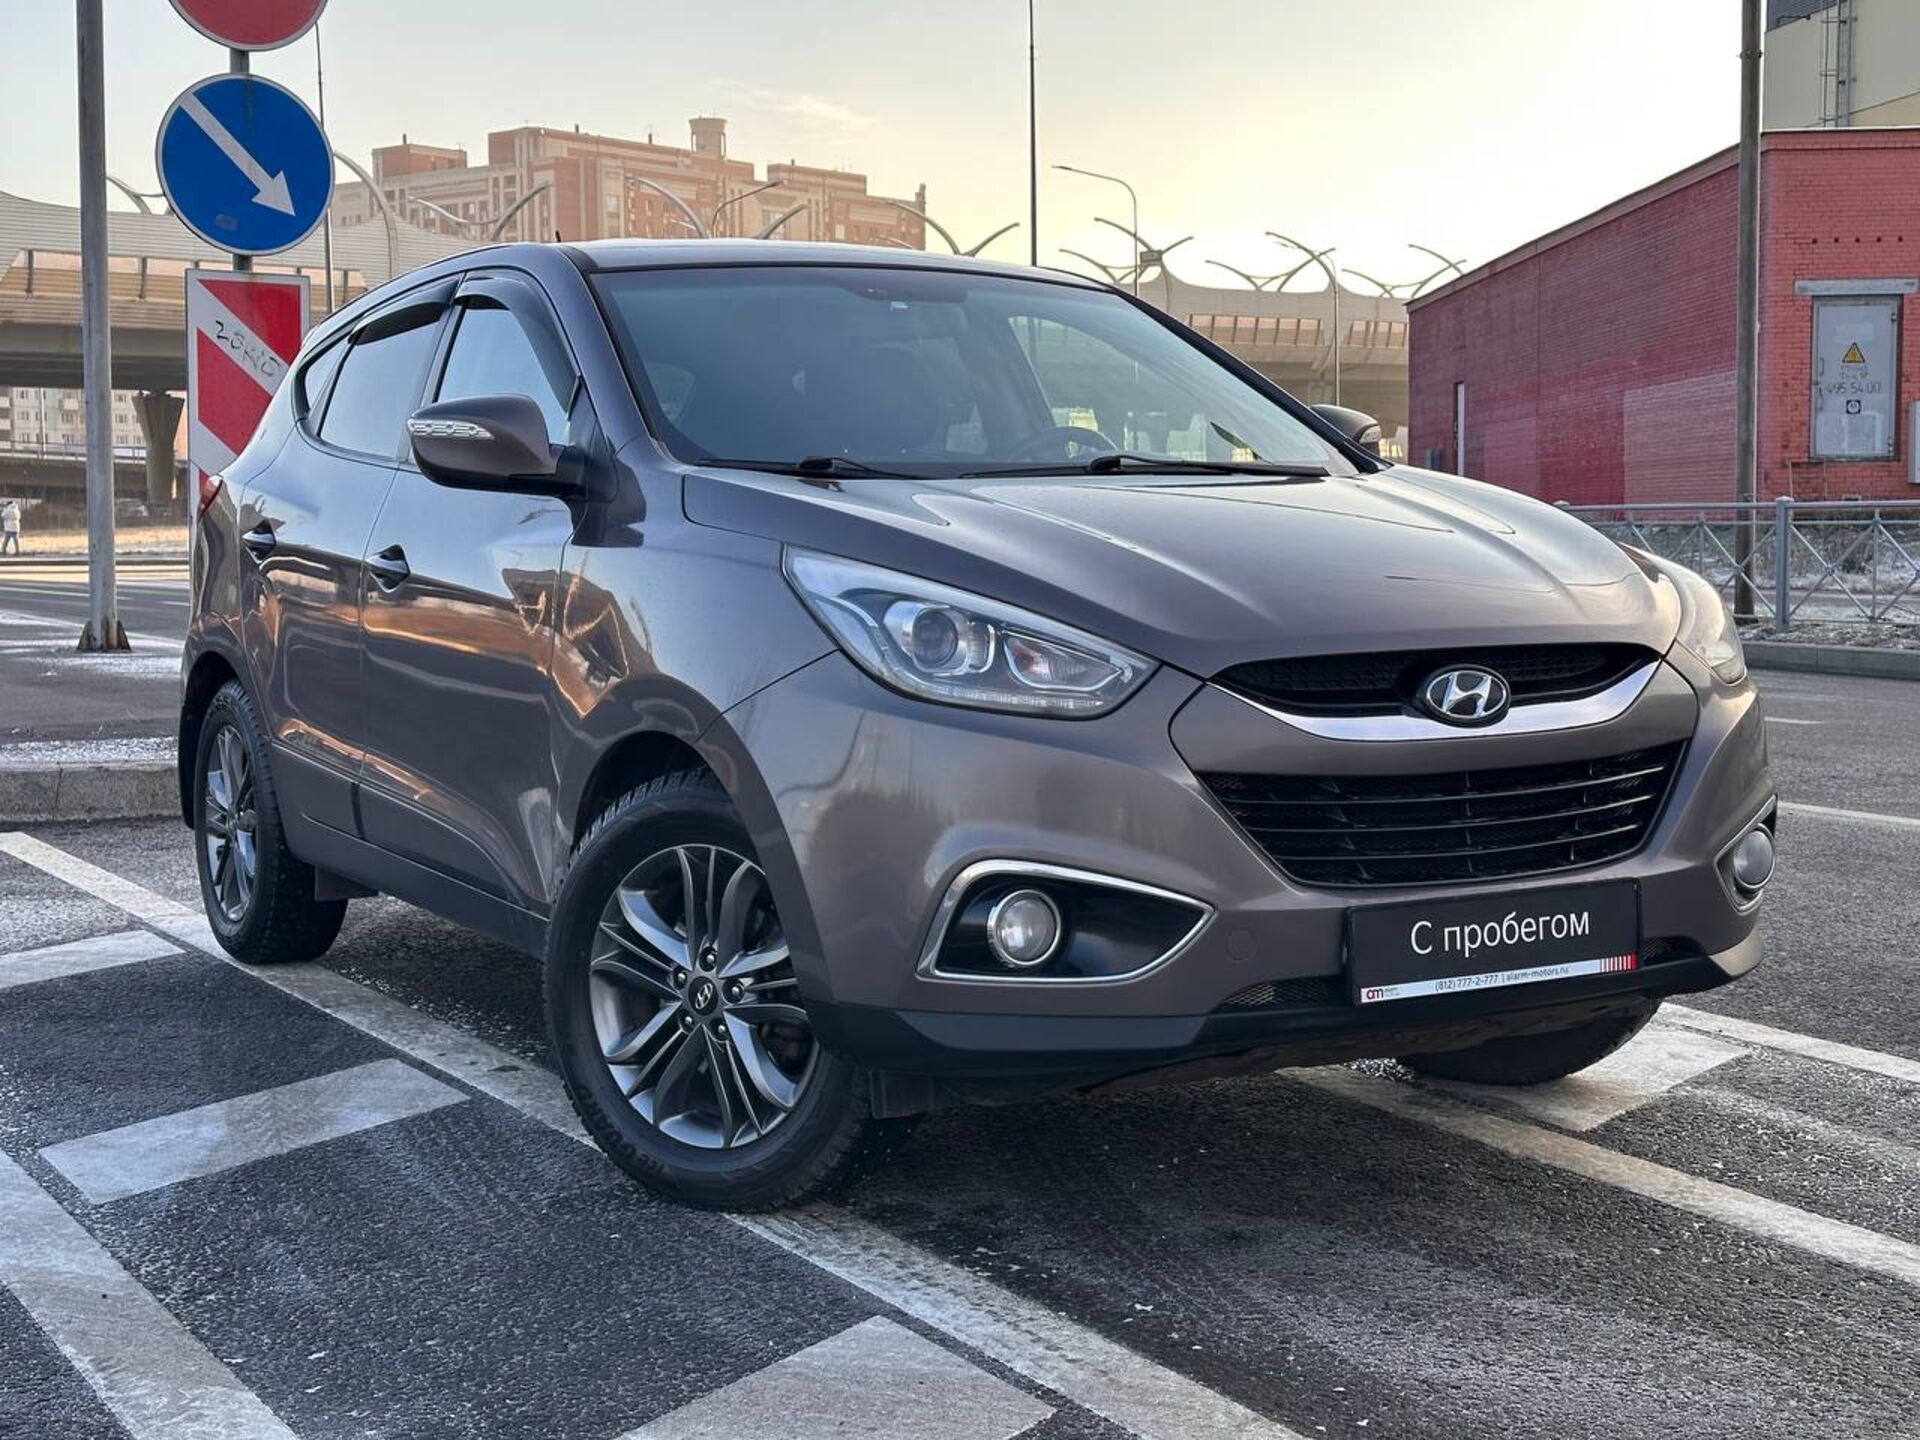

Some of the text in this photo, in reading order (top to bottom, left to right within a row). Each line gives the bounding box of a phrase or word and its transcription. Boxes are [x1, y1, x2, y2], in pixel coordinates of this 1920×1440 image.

[1411, 911, 1590, 958] С пробегом
[1434, 980, 1456, 993] (812)
[1457, 974, 1499, 988] 777-2-777
